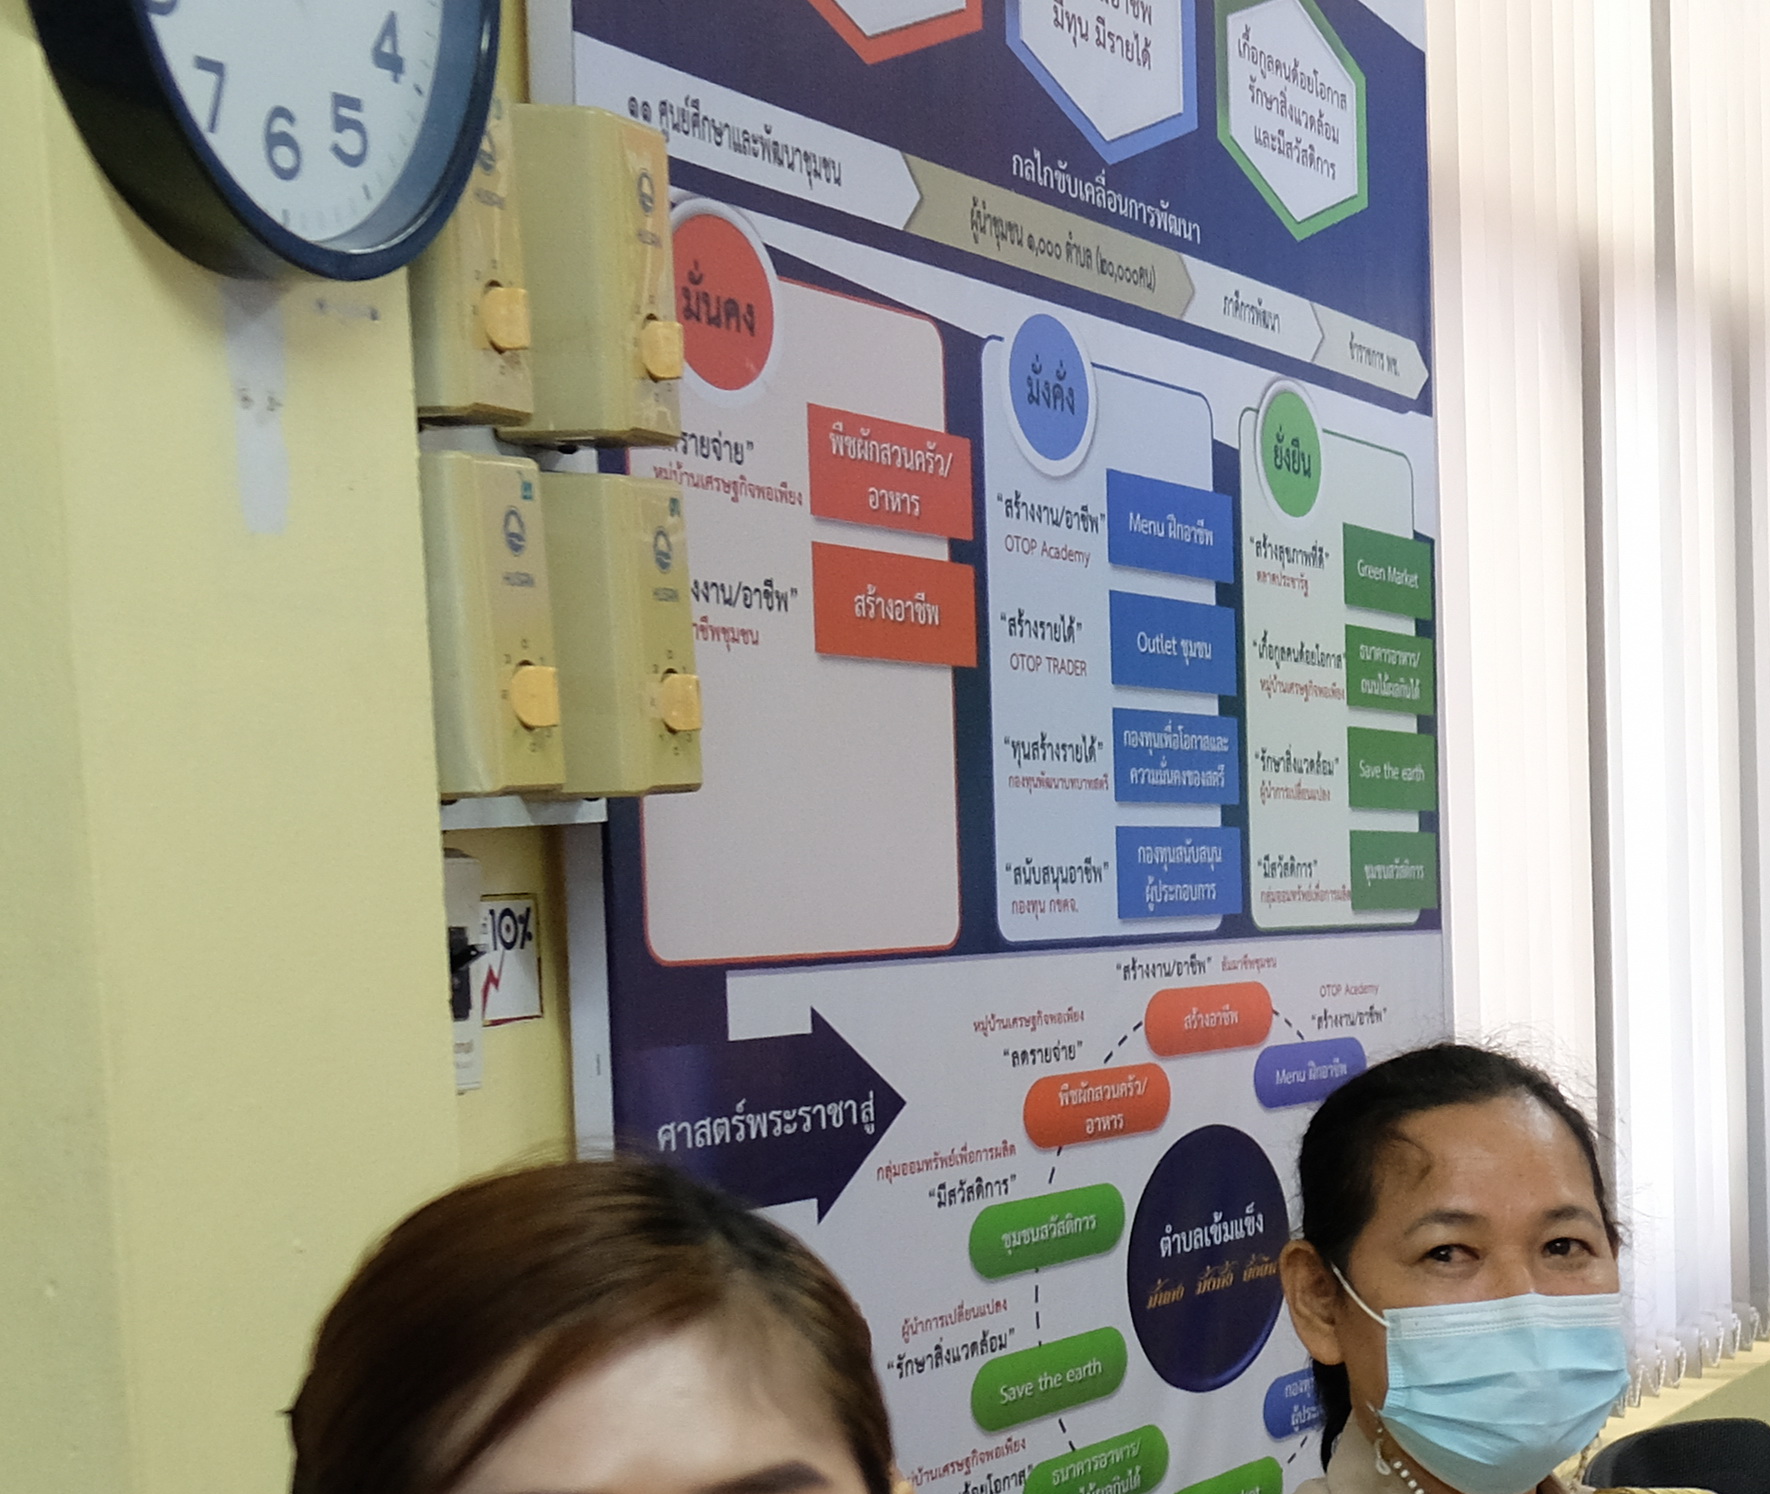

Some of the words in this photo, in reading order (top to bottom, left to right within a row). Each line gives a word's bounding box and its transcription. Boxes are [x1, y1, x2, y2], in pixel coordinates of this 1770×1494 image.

[371, 10, 405, 84] 4
[1052, 0, 1089, 48] มีทุน
[1095, 15, 1152, 71] มีรายได้
[1237, 24, 1347, 111] เกื้อกูลคนด้อยโอกาส
[193, 54, 226, 134] 7
[1248, 75, 1340, 145] รักษาสิ่งแวดล้อม
[265, 105, 302, 181] 6
[330, 90, 368, 168] 5
[1253, 124, 1337, 181] และมีสวัสดิการ
[1011, 150, 1200, 246] กลไกขับเคลื่อนการพัฒนา
[681, 259, 756, 337] มั่นคง
[1026, 355, 1076, 416] มั่งคั่ง
[829, 420, 954, 479] พืชผักสวนครัว/
[1273, 425, 1312, 479] ยั่งยืน
[653, 461, 804, 506] หม่บ้านเศรษฐกิจพอเพียง
[868, 486, 922, 518] อาหาร
[1004, 533, 1037, 556] OTOP
[1041, 540, 1091, 568] Academy
[1129, 512, 1165, 539] Menu
[1357, 559, 1385, 581] Green
[1387, 565, 1420, 589] Market
[854, 583, 941, 626] สร้างอาชีพ
[1009, 653, 1042, 672] OTOP
[1046, 656, 1088, 677] TRADER
[1137, 631, 1178, 656] Outlet
[1359, 759, 1381, 779] Save
[1383, 761, 1399, 780] the
[1401, 763, 1426, 782] earth
[1011, 898, 1045, 920] กองทุน
[1319, 984, 1342, 998] OTOP
[1184, 1004, 1238, 1030] สร้างอาชีพ
[1275, 1067, 1305, 1085] Menu
[657, 1090, 875, 1152] ศาสตร์พระราชาสู่
[1085, 1113, 1124, 1134] อาหาร
[1160, 1201, 1264, 1258] ตำบลเข้มแข็ง
[1000, 1381, 1034, 1405] Save
[1038, 1371, 1063, 1392] the
[1066, 1358, 1103, 1383] earth
